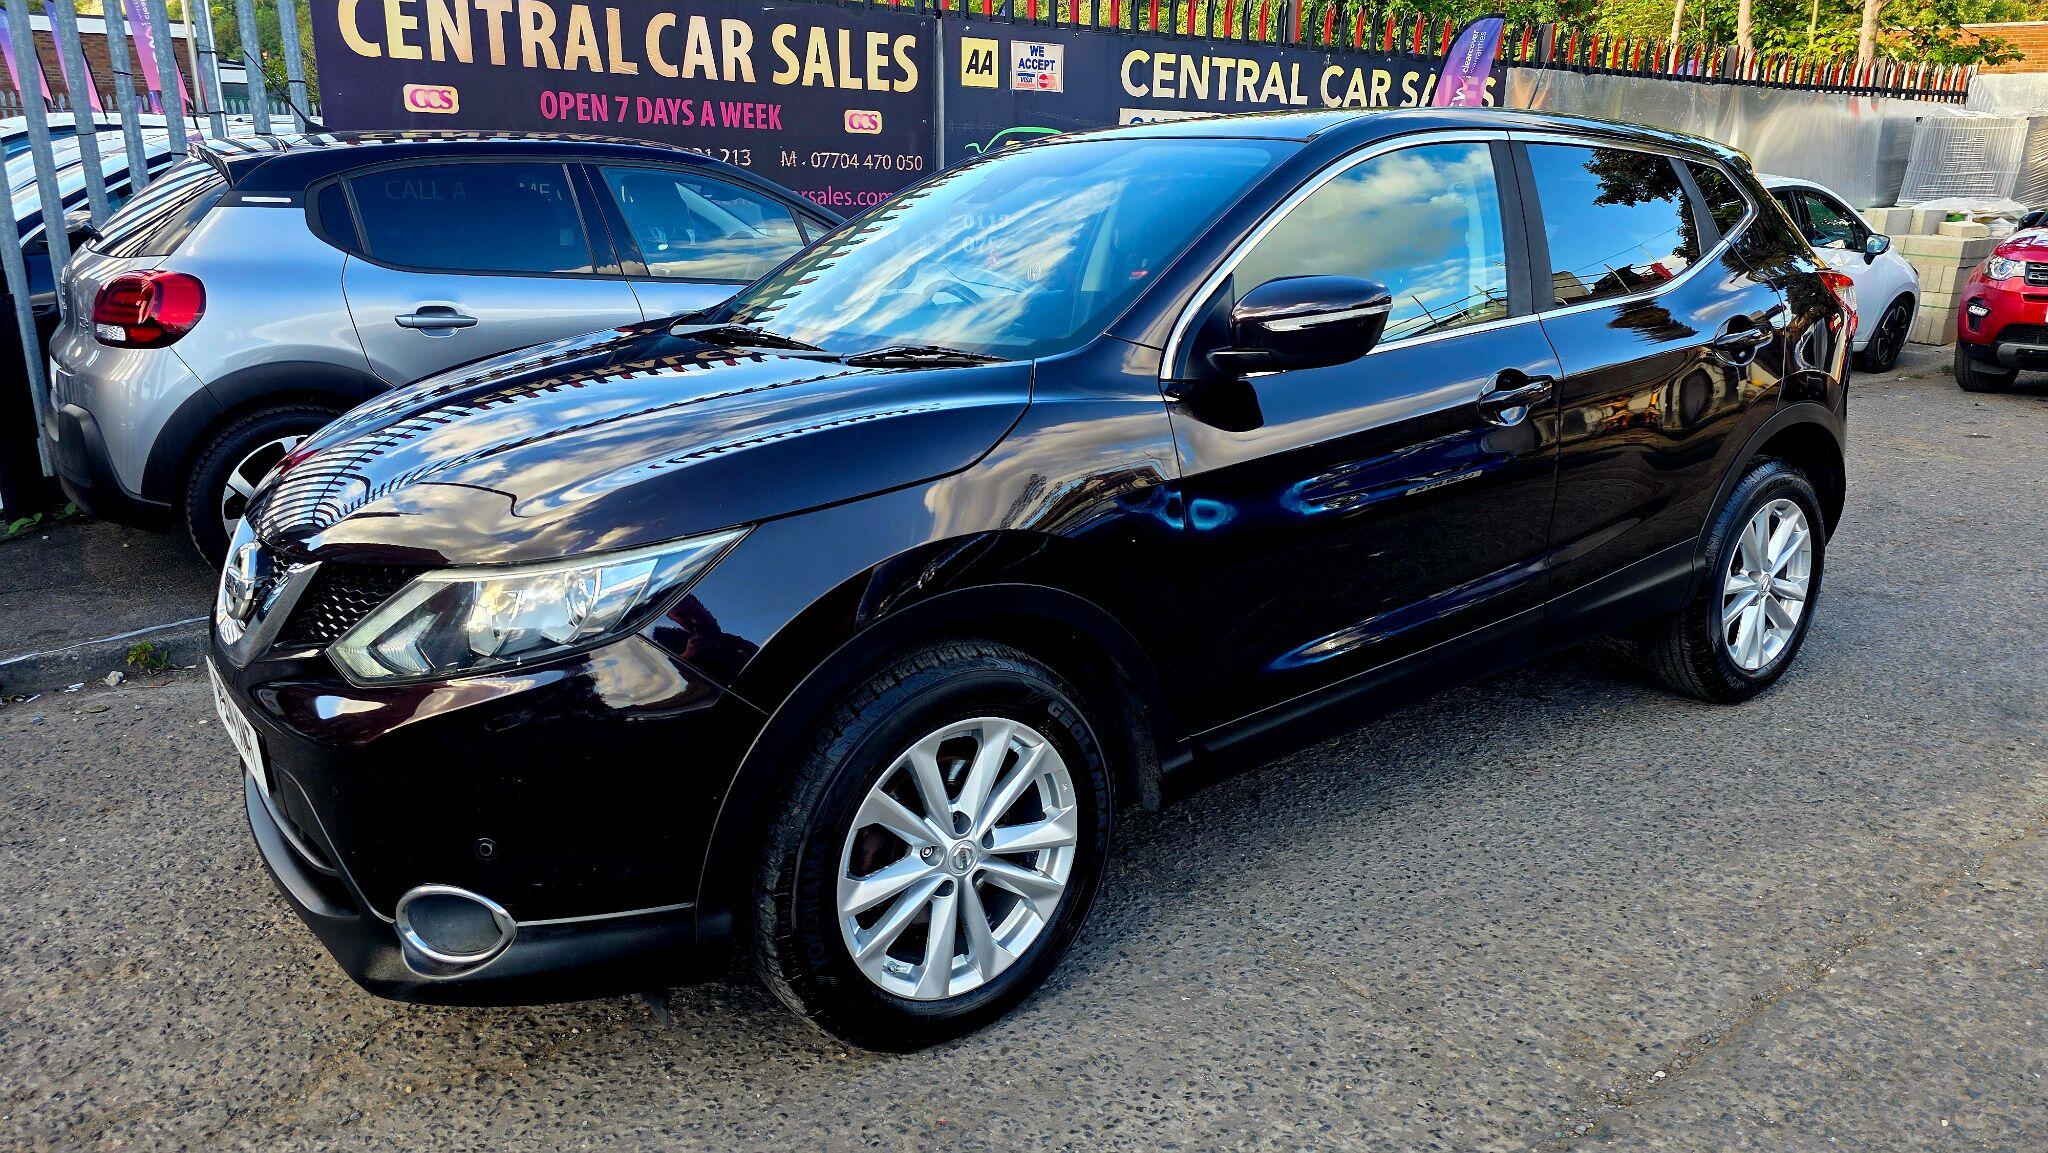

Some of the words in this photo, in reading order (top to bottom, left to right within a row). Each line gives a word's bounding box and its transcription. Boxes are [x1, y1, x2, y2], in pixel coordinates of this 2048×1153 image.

[337, 0, 638, 75] CENTRAL
[645, 12, 756, 83] CAR
[771, 23, 919, 93] SALES
[1029, 45, 1045, 58] WE
[965, 48, 993, 76] AA
[1017, 57, 1056, 72] ACCEPT
[1120, 49, 1308, 105] CENTRAL
[1320, 65, 1392, 108] CAR
[1399, 71, 1497, 107] SAS
[540, 90, 608, 122] OPEN
[614, 96, 629, 123] 7
[637, 96, 695, 127] DAYS
[700, 100, 716, 128] A
[720, 102, 783, 131] WEEK
[811, 152, 860, 169] 07704
[863, 154, 892, 171] 470
[896, 155, 923, 171] 050
